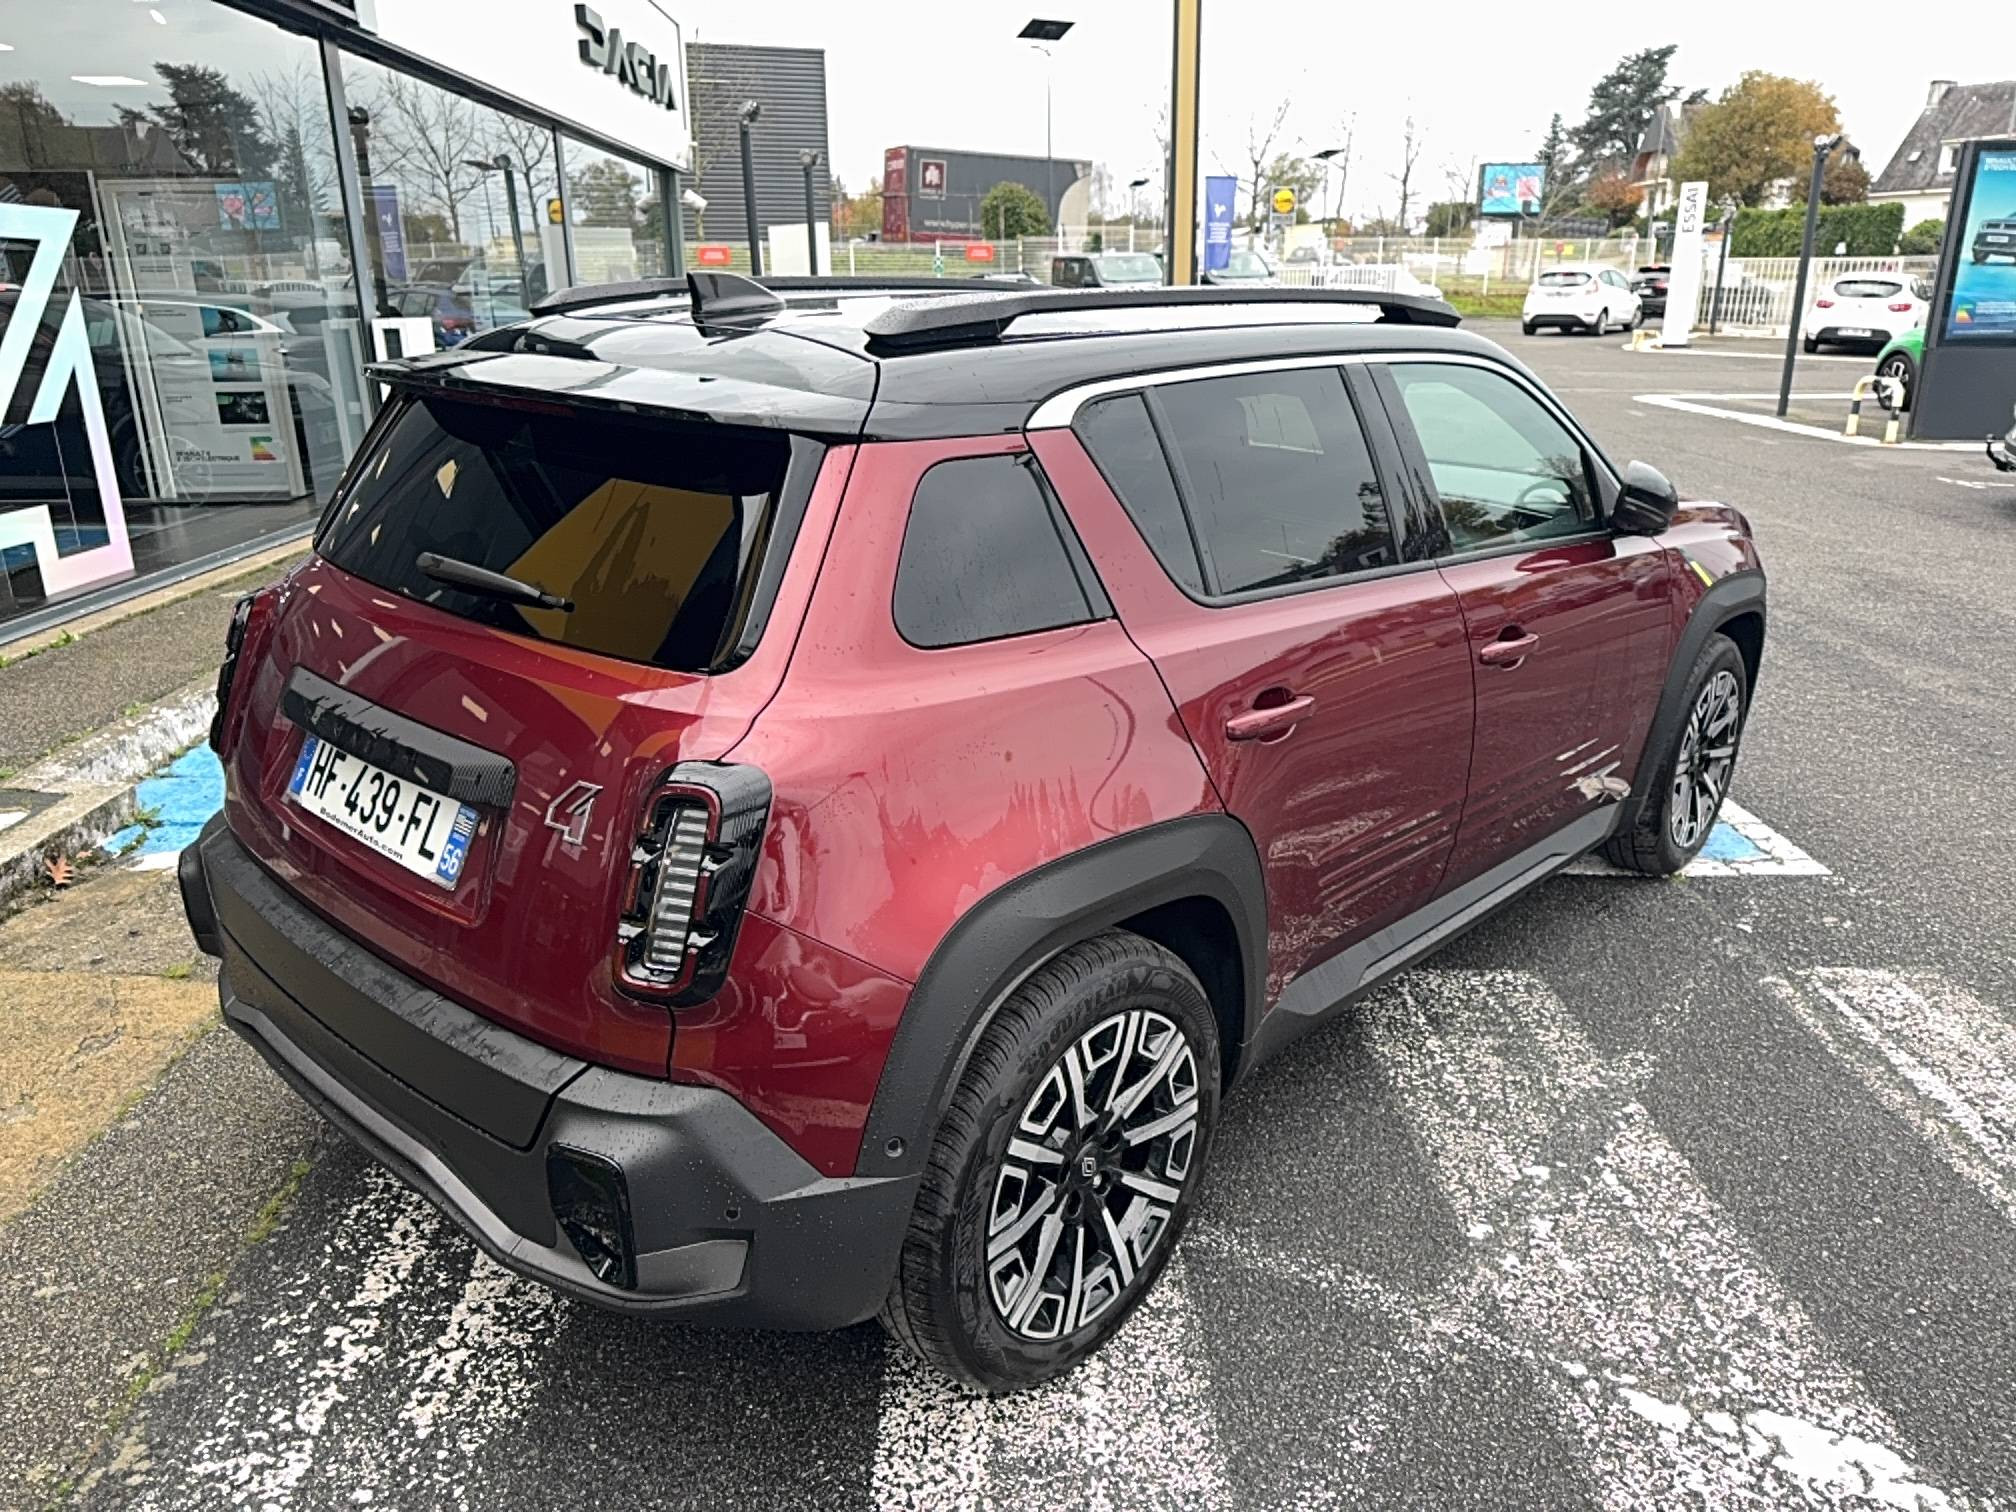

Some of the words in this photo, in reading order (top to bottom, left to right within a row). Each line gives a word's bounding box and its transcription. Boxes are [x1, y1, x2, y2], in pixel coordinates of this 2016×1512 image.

[574, 4, 677, 110] DACIA
[1682, 187, 1698, 233] ESSAI
[306, 743, 441, 861] HF-439-FL
[320, 807, 403, 860] BodemerAuto.com
[440, 843, 461, 875] 56
